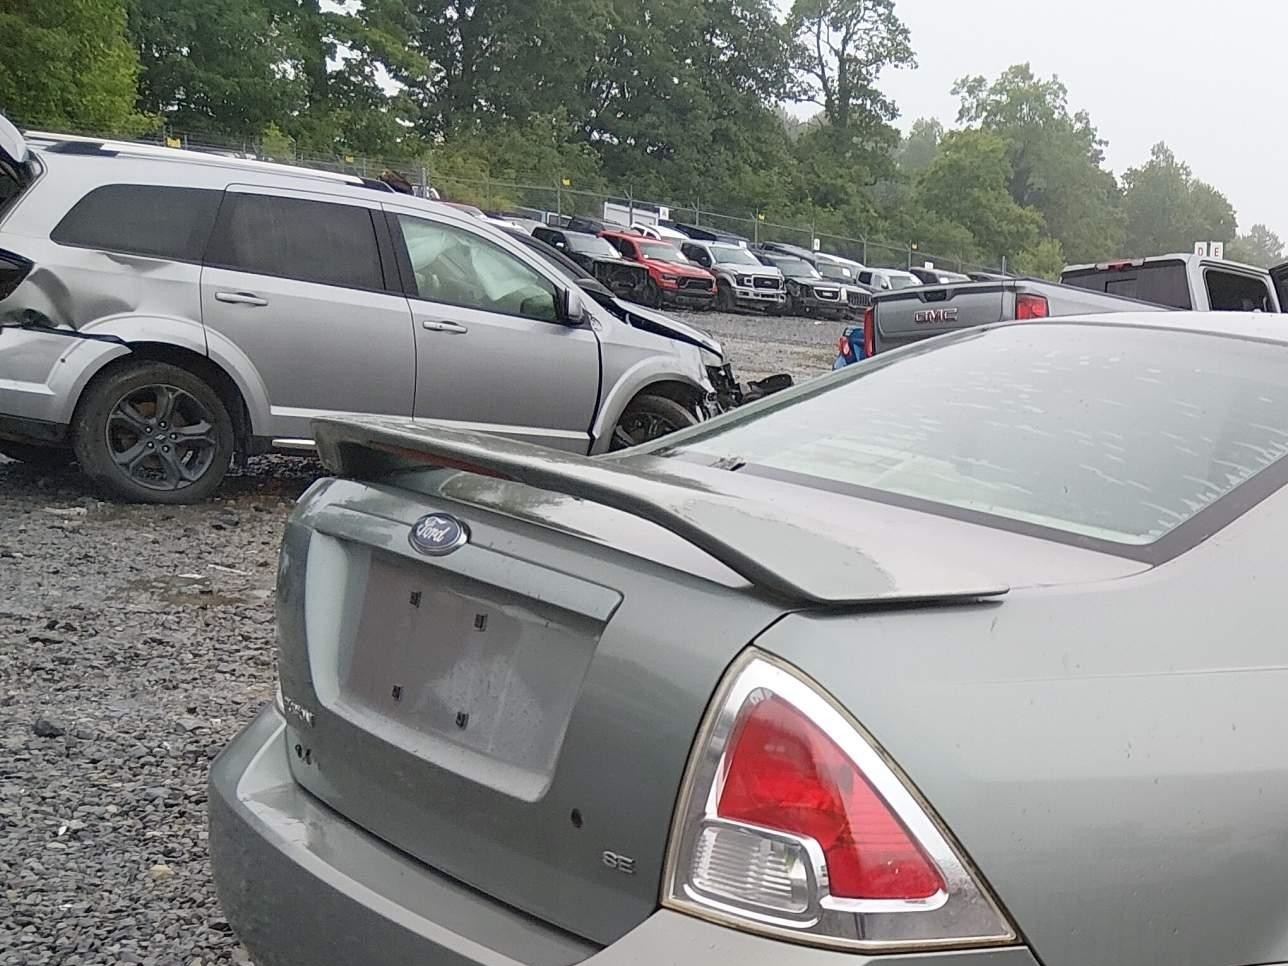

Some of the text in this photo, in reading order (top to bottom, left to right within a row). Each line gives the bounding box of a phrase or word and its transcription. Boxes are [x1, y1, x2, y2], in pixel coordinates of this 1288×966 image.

[1214, 247, 1220, 256] E
[914, 308, 957, 322] GMC
[417, 516, 450, 542] Ford
[603, 851, 633, 873] SE
